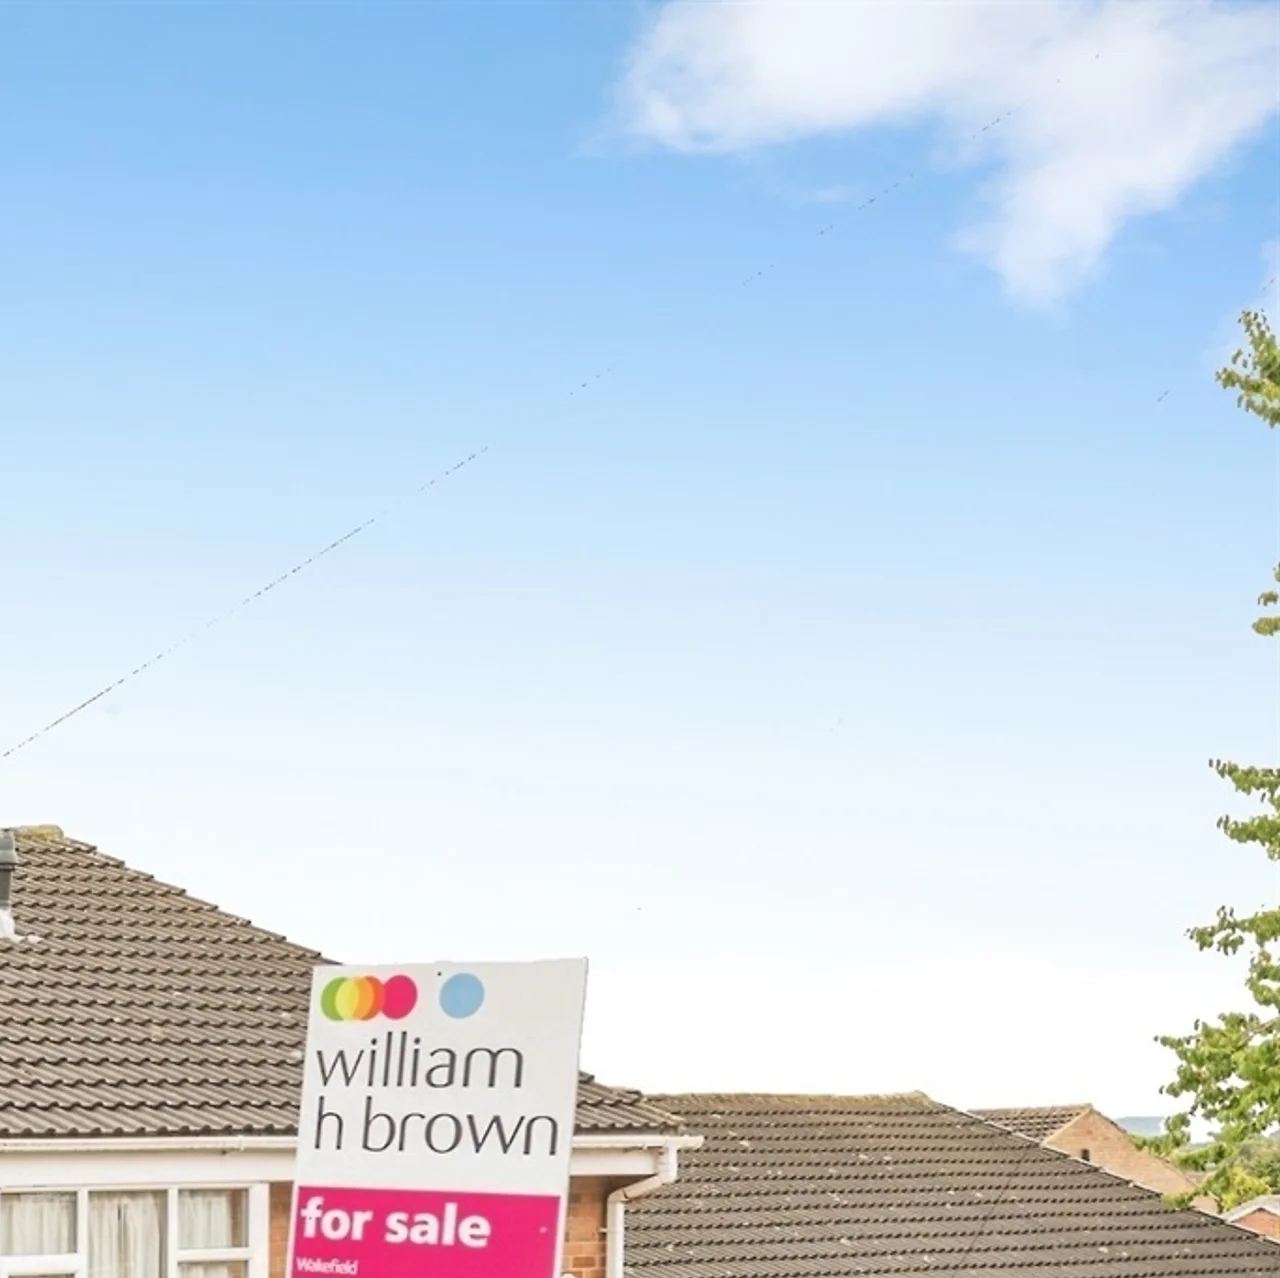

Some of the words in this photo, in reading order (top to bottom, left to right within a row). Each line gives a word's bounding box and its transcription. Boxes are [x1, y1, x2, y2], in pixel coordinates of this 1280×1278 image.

[316, 1031, 524, 1088] william
[314, 1096, 344, 1151] h
[362, 1096, 559, 1156] brown
[300, 1196, 374, 1241] for
[384, 1202, 492, 1248] sale
[296, 1257, 359, 1275] Wakefield
